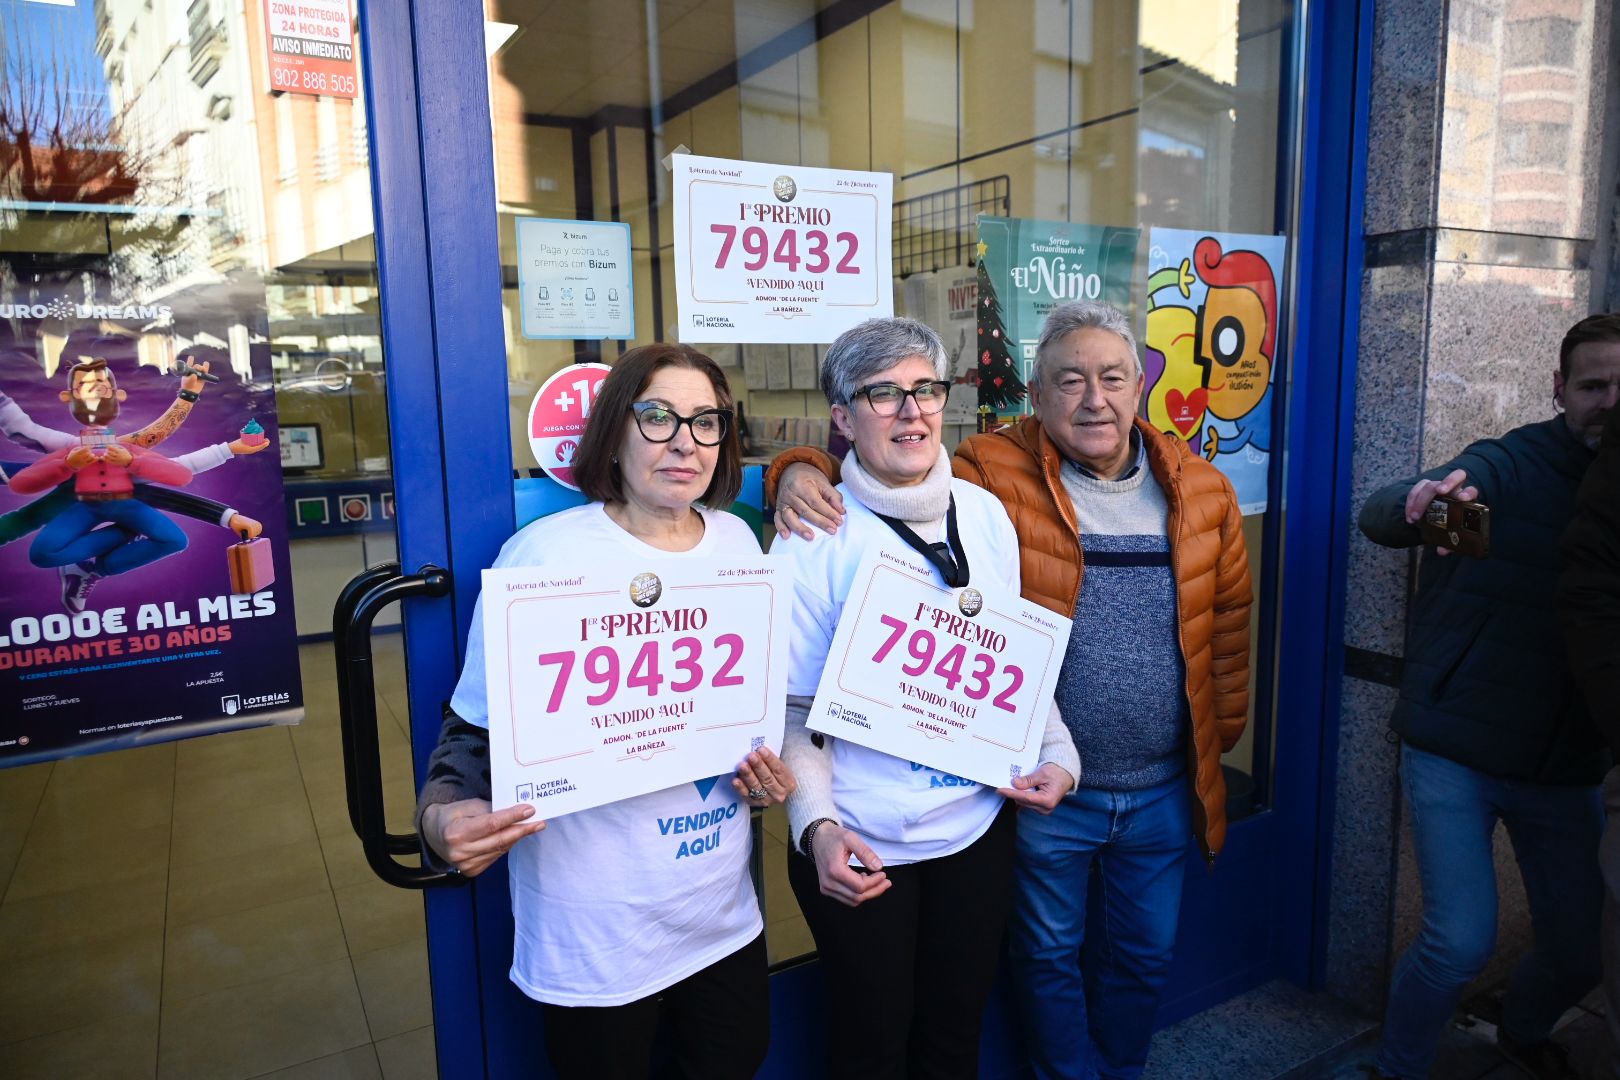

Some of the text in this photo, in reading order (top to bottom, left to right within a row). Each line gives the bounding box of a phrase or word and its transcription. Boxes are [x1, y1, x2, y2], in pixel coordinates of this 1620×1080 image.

[272, 2, 346, 23] ZONA PROTEGIDA
[281, 20, 340, 38] 24 HORAS
[272, 37, 352, 60] AVISO INMEDIATO
[274, 67, 354, 94] 902 886 505
[850, 180, 879, 189] Diciembre
[753, 203, 831, 226] PREMIO
[570, 232, 588, 240] bizum
[1048, 236, 1070, 246] Sorteo
[540, 243, 610, 257] Paga y cobra tus
[710, 223, 861, 275] 79432
[1031, 243, 1086, 255] Extraordinario de
[534, 259, 617, 271] premios con Bizum
[746, 277, 824, 292] VENDIDO AQUÍ
[1010, 256, 1101, 301] El Niño
[75, 303, 172, 319] DREAMS
[736, 567, 775, 577] Diciembre
[538, 580, 548, 588] de
[137, 602, 190, 631] AL
[198, 591, 277, 623] MES
[1021, 610, 1029, 618] 22
[601, 607, 708, 638] PREMIO
[931, 608, 1007, 654] PREMIO
[0, 624, 232, 670] DURANTE 30 AÑOS
[48, 667, 79, 677] ESTRÉS
[162, 654, 178, 662] UNA
[871, 613, 1024, 714] 79432
[538, 633, 745, 714] 79432
[196, 678, 225, 686] APUESTA
[23, 702, 48, 711] LUNES
[53, 697, 80, 706] JUEVES
[243, 692, 290, 705] LOTERÍAS
[898, 682, 978, 719] VENDIDO AQUÍ
[591, 698, 694, 729] VENDIDO AQUÍ
[843, 708, 868, 722] LOTERÍA
[901, 703, 925, 715] ADMON.
[79, 726, 106, 735] Normas
[117, 715, 183, 729] loteriasyapuestas.es
[841, 715, 872, 730] NACIONAL
[916, 720, 948, 736] LA BAÑEZA
[603, 733, 634, 745] ADMON.
[648, 727, 657, 736] LA
[658, 722, 688, 734] FUENTE"
[637, 740, 666, 752] BAÑEZA
[536, 777, 569, 792] LOTERÍA
[536, 784, 577, 799] NACIONAL
[657, 802, 738, 836] VENDIDO
[675, 825, 722, 860] AQUÍ
